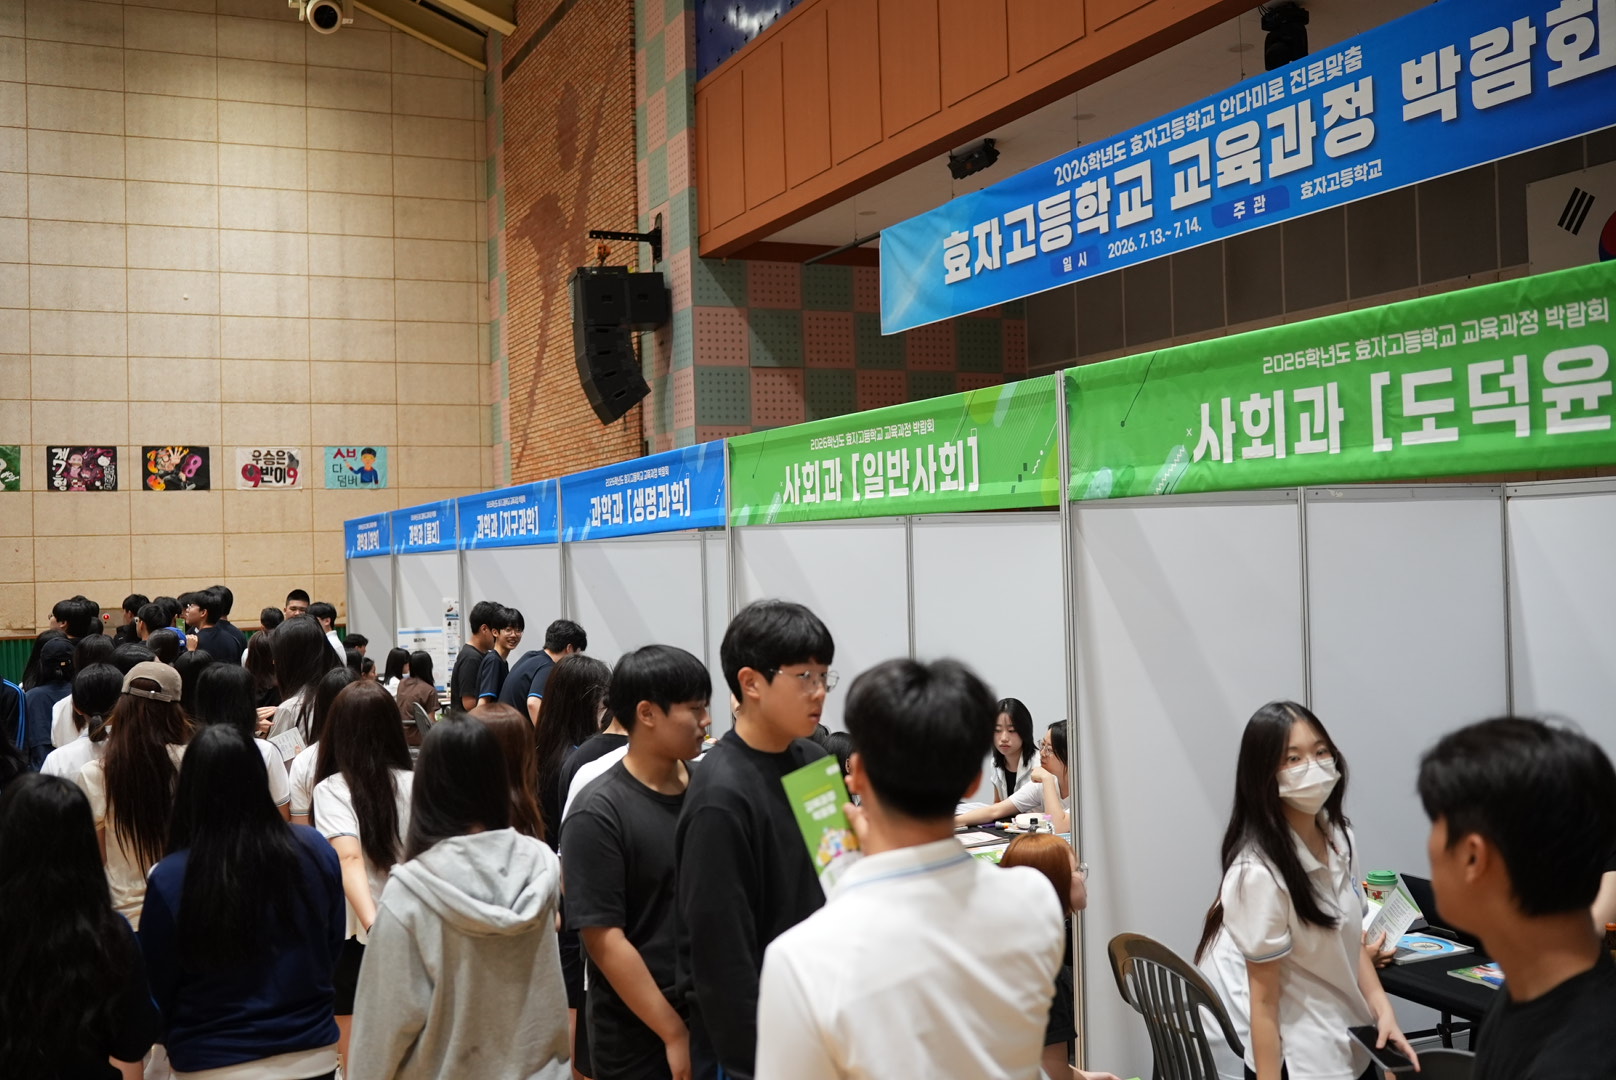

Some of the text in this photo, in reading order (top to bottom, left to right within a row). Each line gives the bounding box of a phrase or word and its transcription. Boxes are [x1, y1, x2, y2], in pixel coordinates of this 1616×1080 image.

[1053, 45, 1363, 187] 2026학년도 효자고등학교 안다미로 진로맞춤
[943, 0, 1616, 285] 효자고등학교 교육과정 박람회
[1300, 159, 1383, 200] 효자고등학교
[1263, 297, 1610, 374] 2026학년도 효자고등학교 교육과정 박람회
[810, 433, 845, 451] 2026학년도
[884, 422, 912, 440] 교육과정
[913, 418, 935, 435] 박람회
[1193, 381, 1345, 464] 사회과
[252, 449, 286, 466] 우승은
[332, 463, 343, 474] 다
[782, 436, 980, 505] 사회과 [일반사회]
[476, 505, 539, 539] 과학과 [지구과학]
[590, 478, 691, 527] 과학과 [생명과학]
